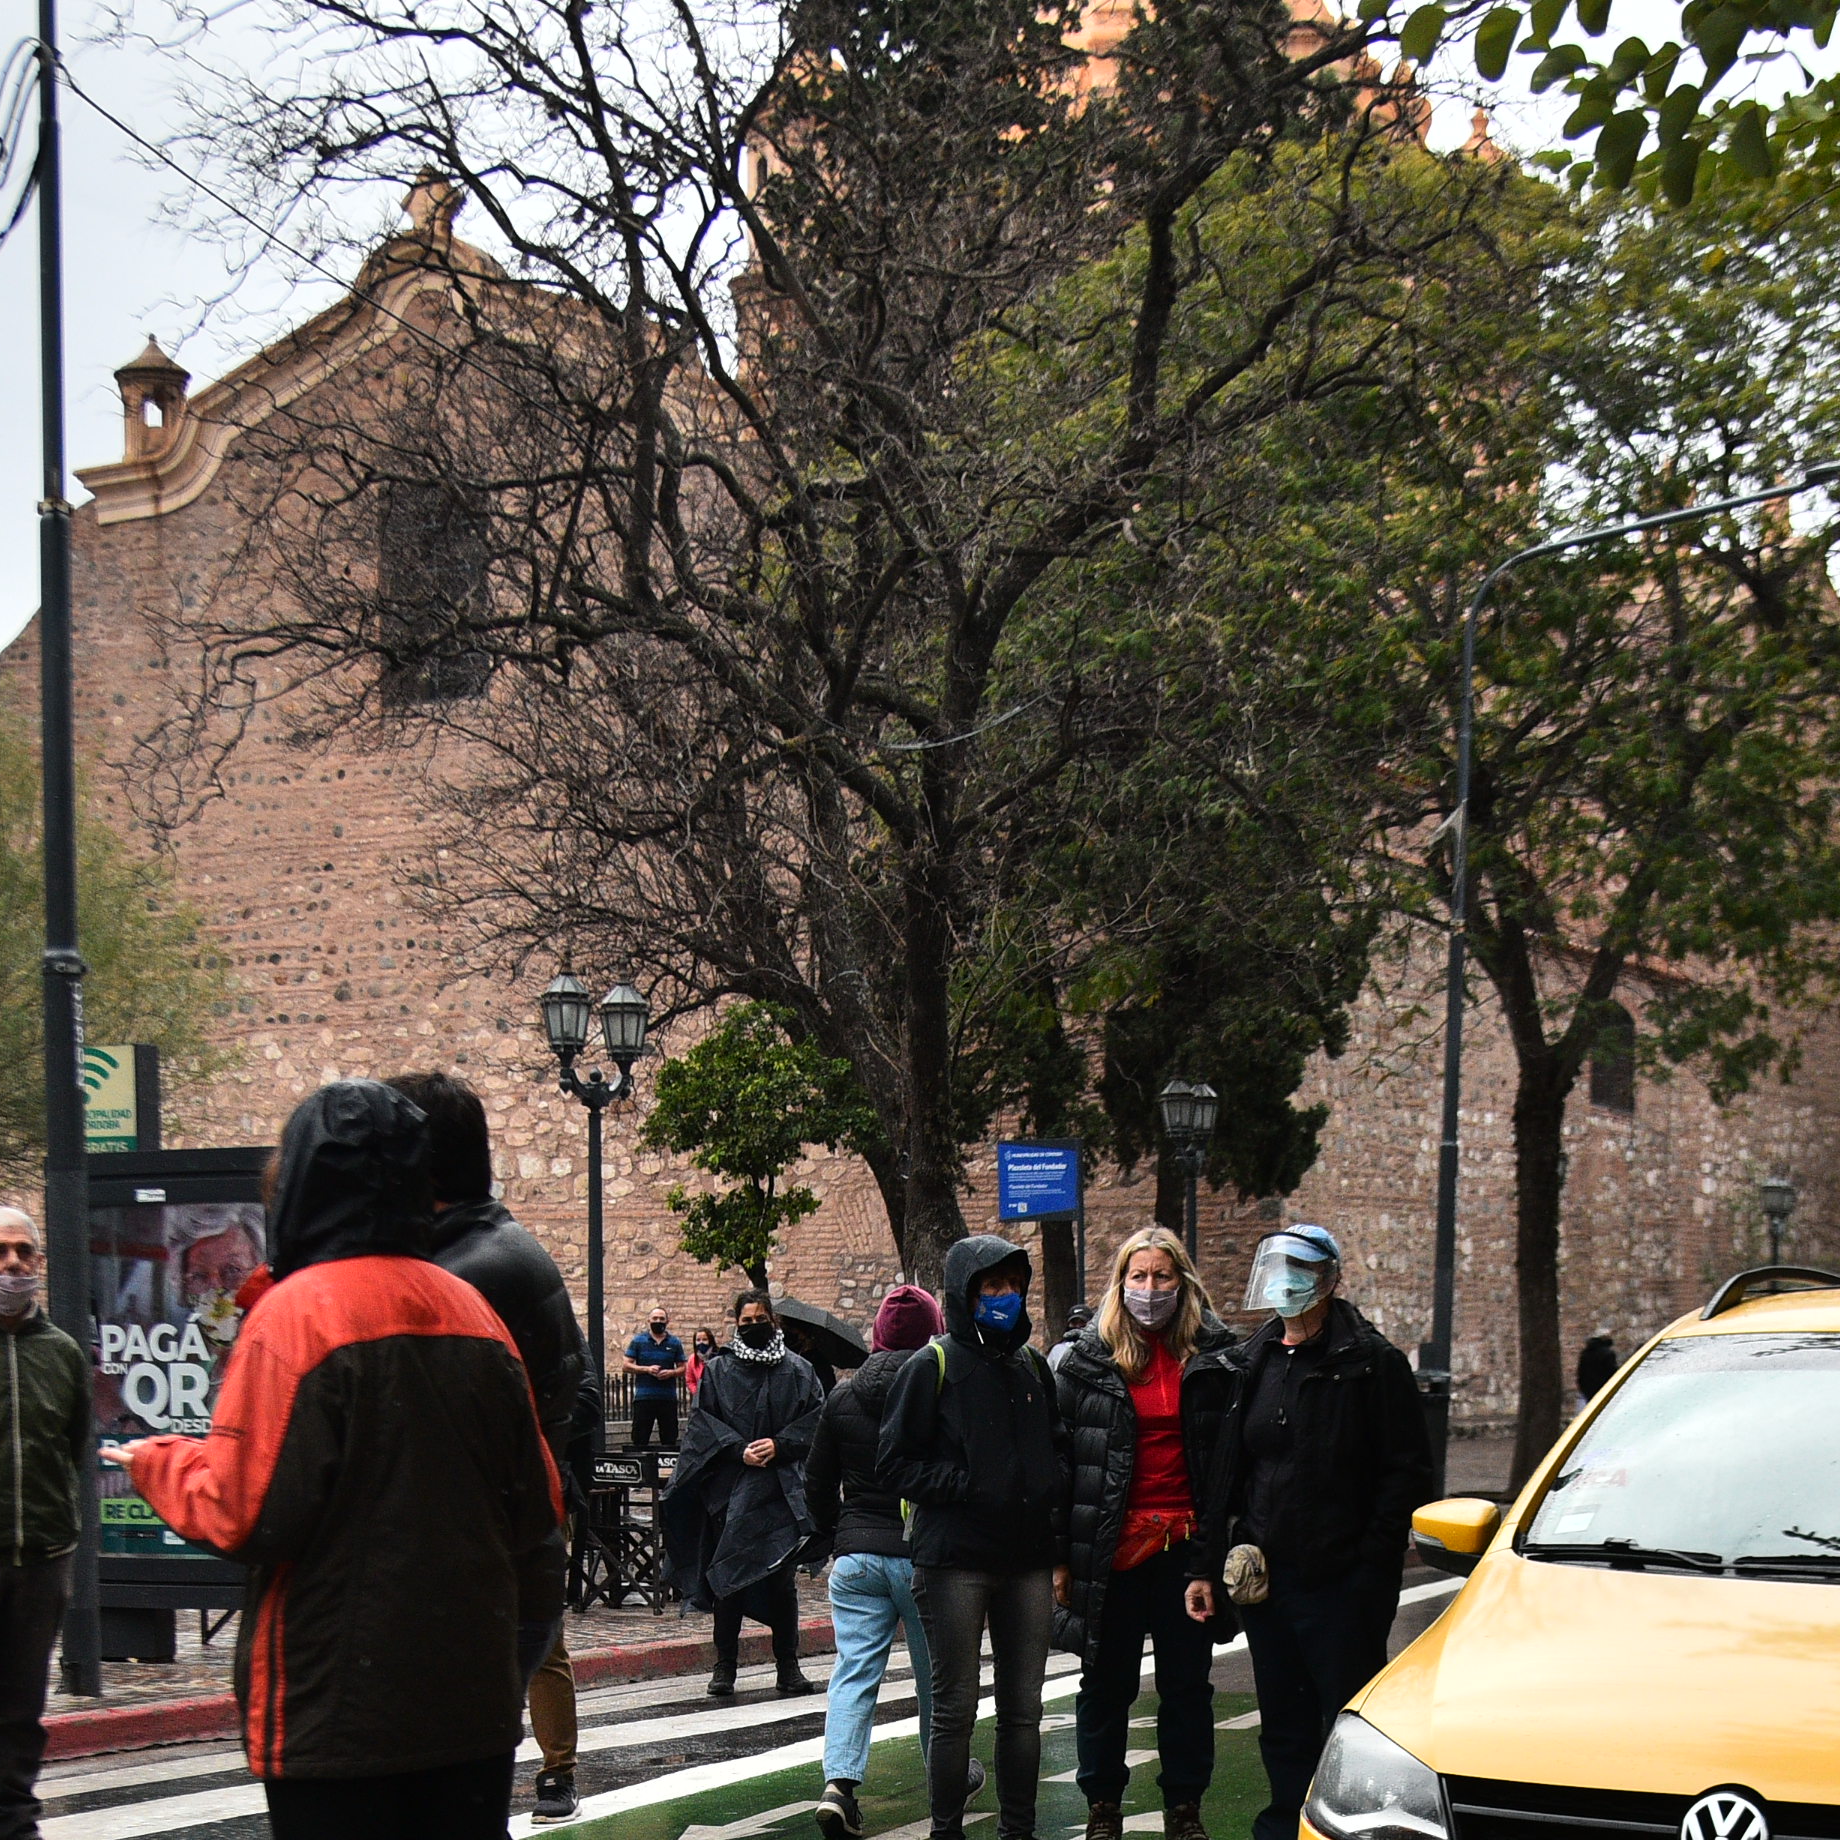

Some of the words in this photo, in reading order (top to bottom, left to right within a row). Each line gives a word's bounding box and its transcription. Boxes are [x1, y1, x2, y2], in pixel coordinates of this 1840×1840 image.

[99, 1313, 211, 1362] PAGÁ
[103, 1362, 128, 1375] CON
[123, 1362, 211, 1429] QR
[171, 1418, 213, 1433] DESD
[604, 1462, 637, 1474] TASCA
